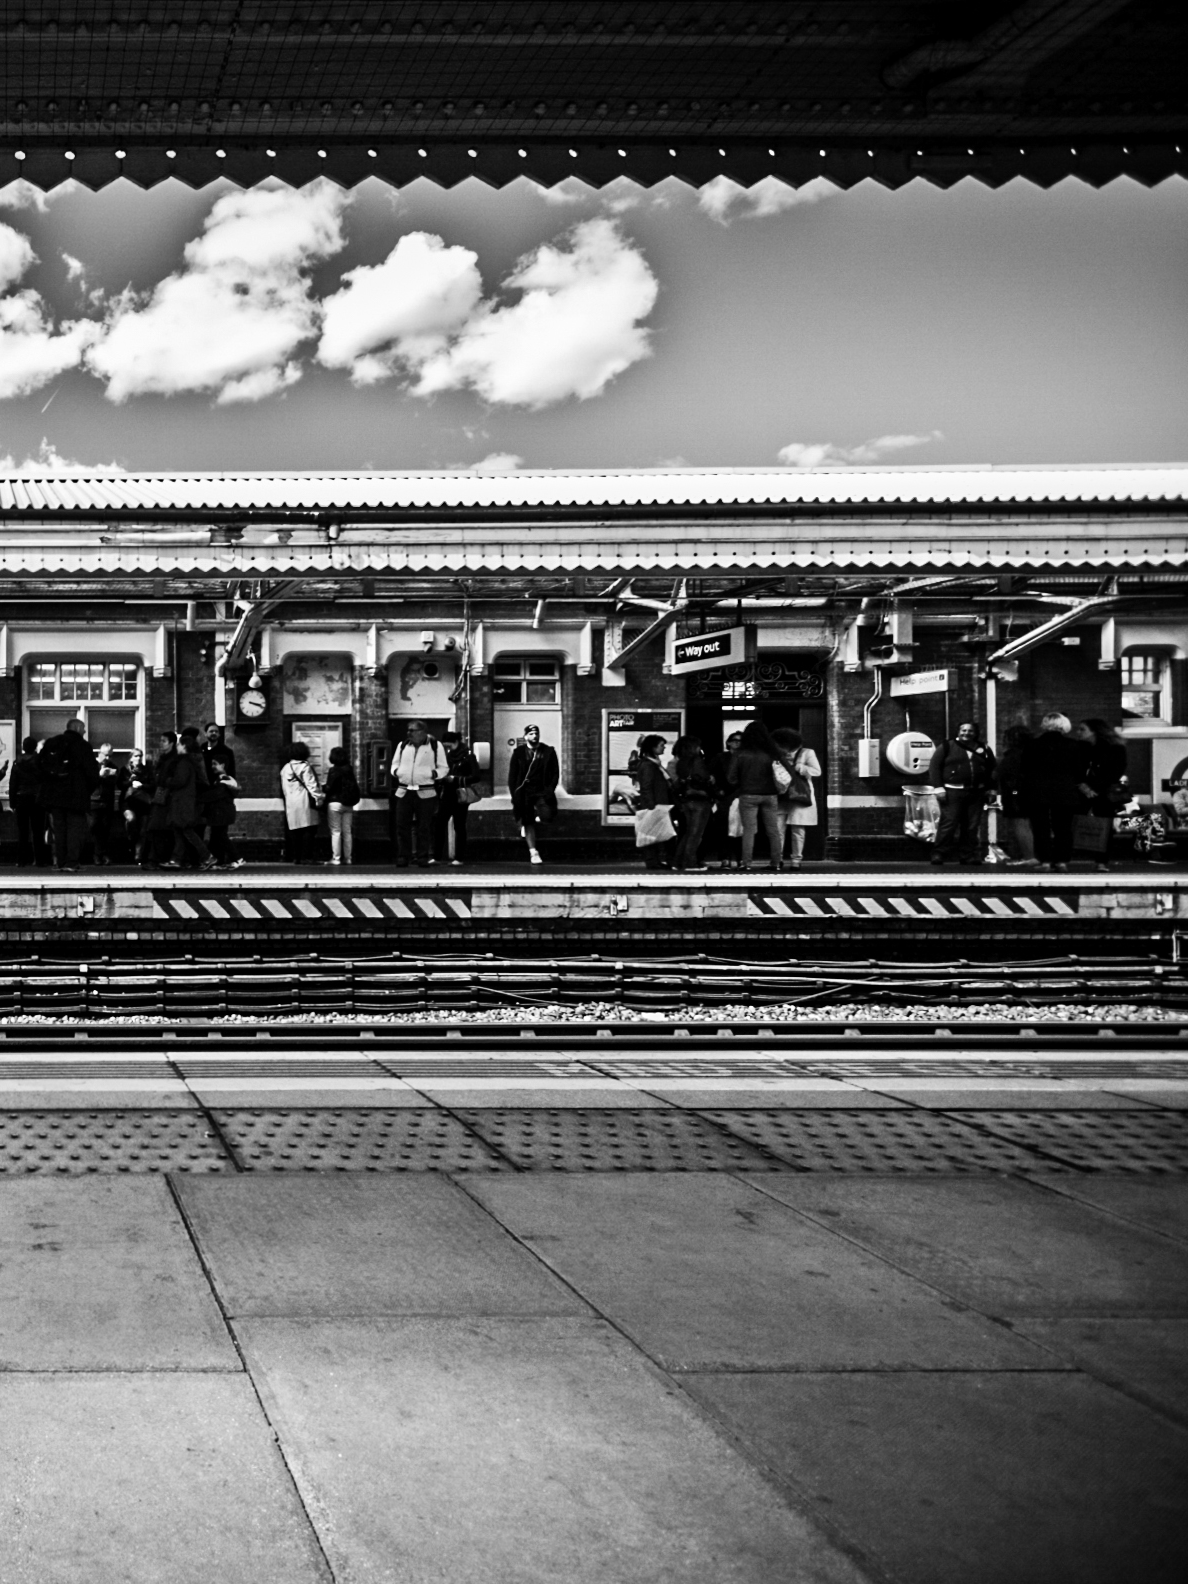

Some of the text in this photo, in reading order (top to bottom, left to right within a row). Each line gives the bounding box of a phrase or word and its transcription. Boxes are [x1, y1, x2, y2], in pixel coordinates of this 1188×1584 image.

[685, 641, 720, 657] Way out
[900, 676, 938, 685] Help point
[609, 713, 635, 721] PHOTO
[533, 1063, 733, 1077] MIND
[736, 1063, 902, 1077] THE
